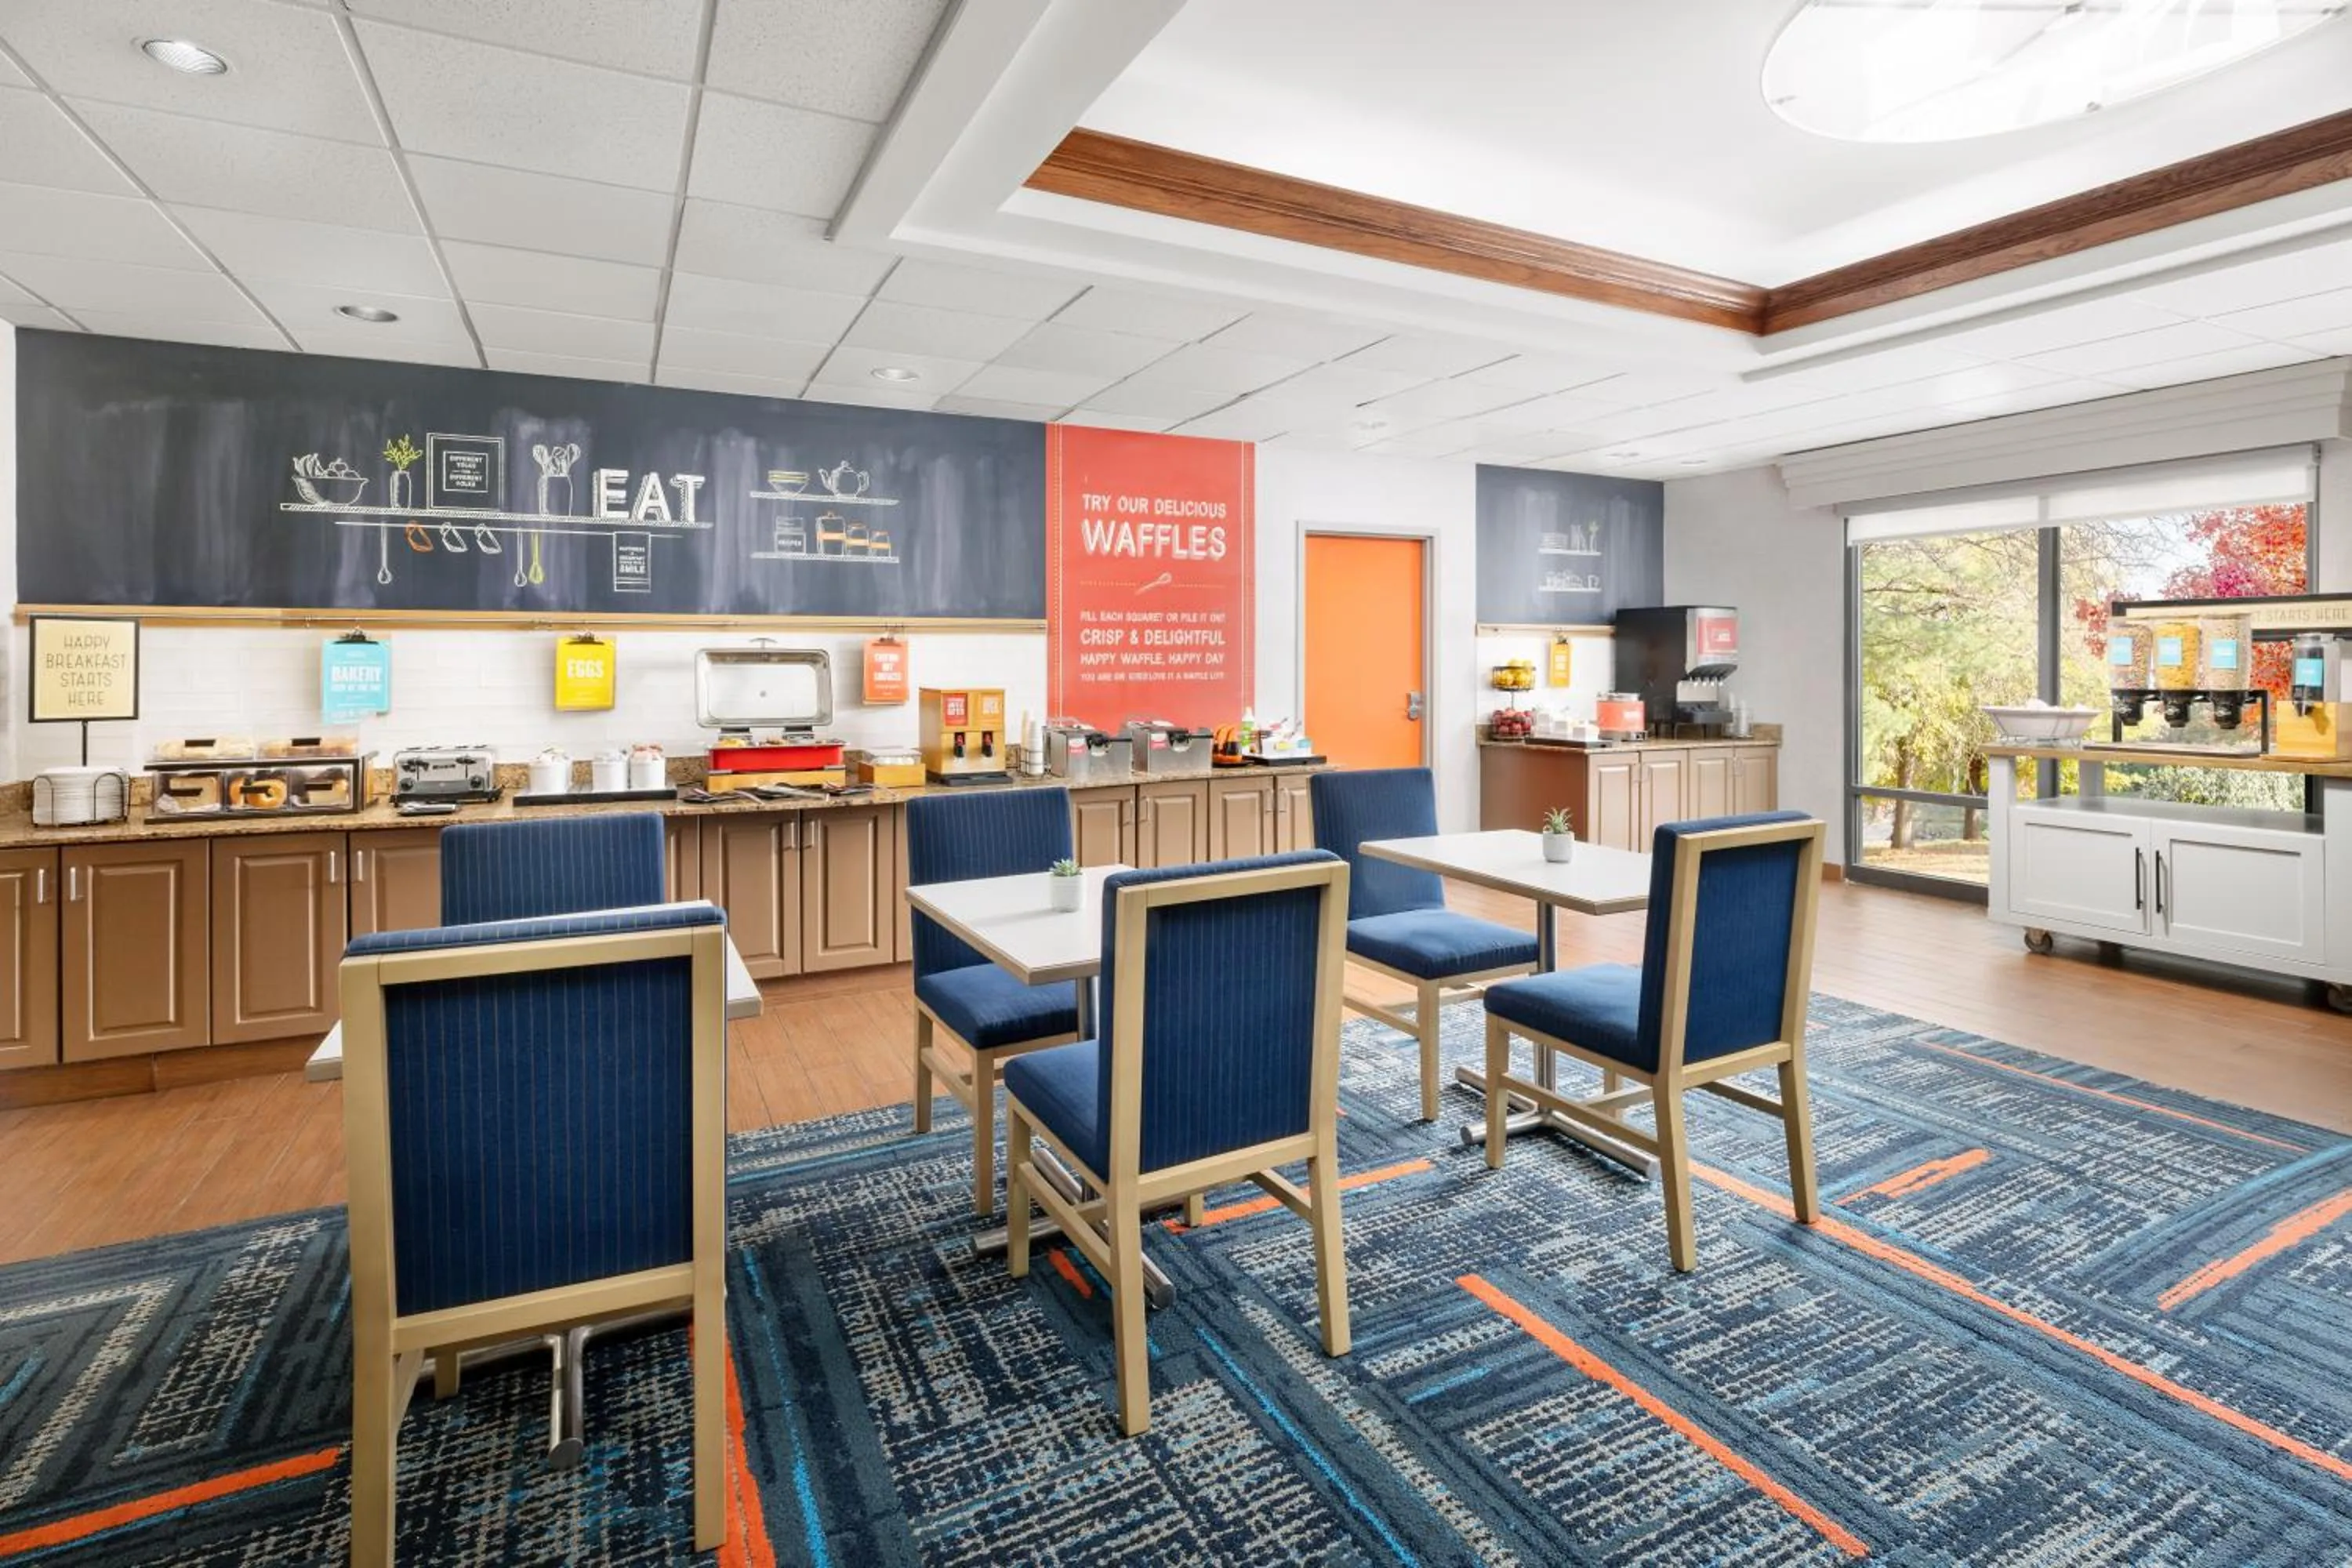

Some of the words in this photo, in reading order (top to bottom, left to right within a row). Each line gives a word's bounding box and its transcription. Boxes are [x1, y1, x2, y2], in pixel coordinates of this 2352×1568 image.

[593, 469, 706, 524] EAT
[1082, 493, 1111, 512] TRY
[1117, 495, 1149, 514] OUR
[1154, 499, 1227, 519] DELICIOUS
[1081, 518, 1228, 561] WAFFLES
[1100, 612, 1123, 622] EACH
[1166, 613, 1178, 623] OR
[64, 634, 111, 650] HAPPY
[1080, 629, 1124, 645] CRISP
[1129, 630, 1139, 645] &
[1144, 630, 1226, 645] DELIGHTFUL
[45, 652, 125, 670] BREAKFAST
[1080, 652, 1116, 666] HAPPY
[1168, 652, 1202, 666] HAPPY
[1205, 652, 1225, 665] DAY
[332, 665, 382, 683] BAKERY
[567, 659, 604, 679] EGGS
[61, 672, 112, 688] STARTS
[68, 691, 105, 706] HERE
